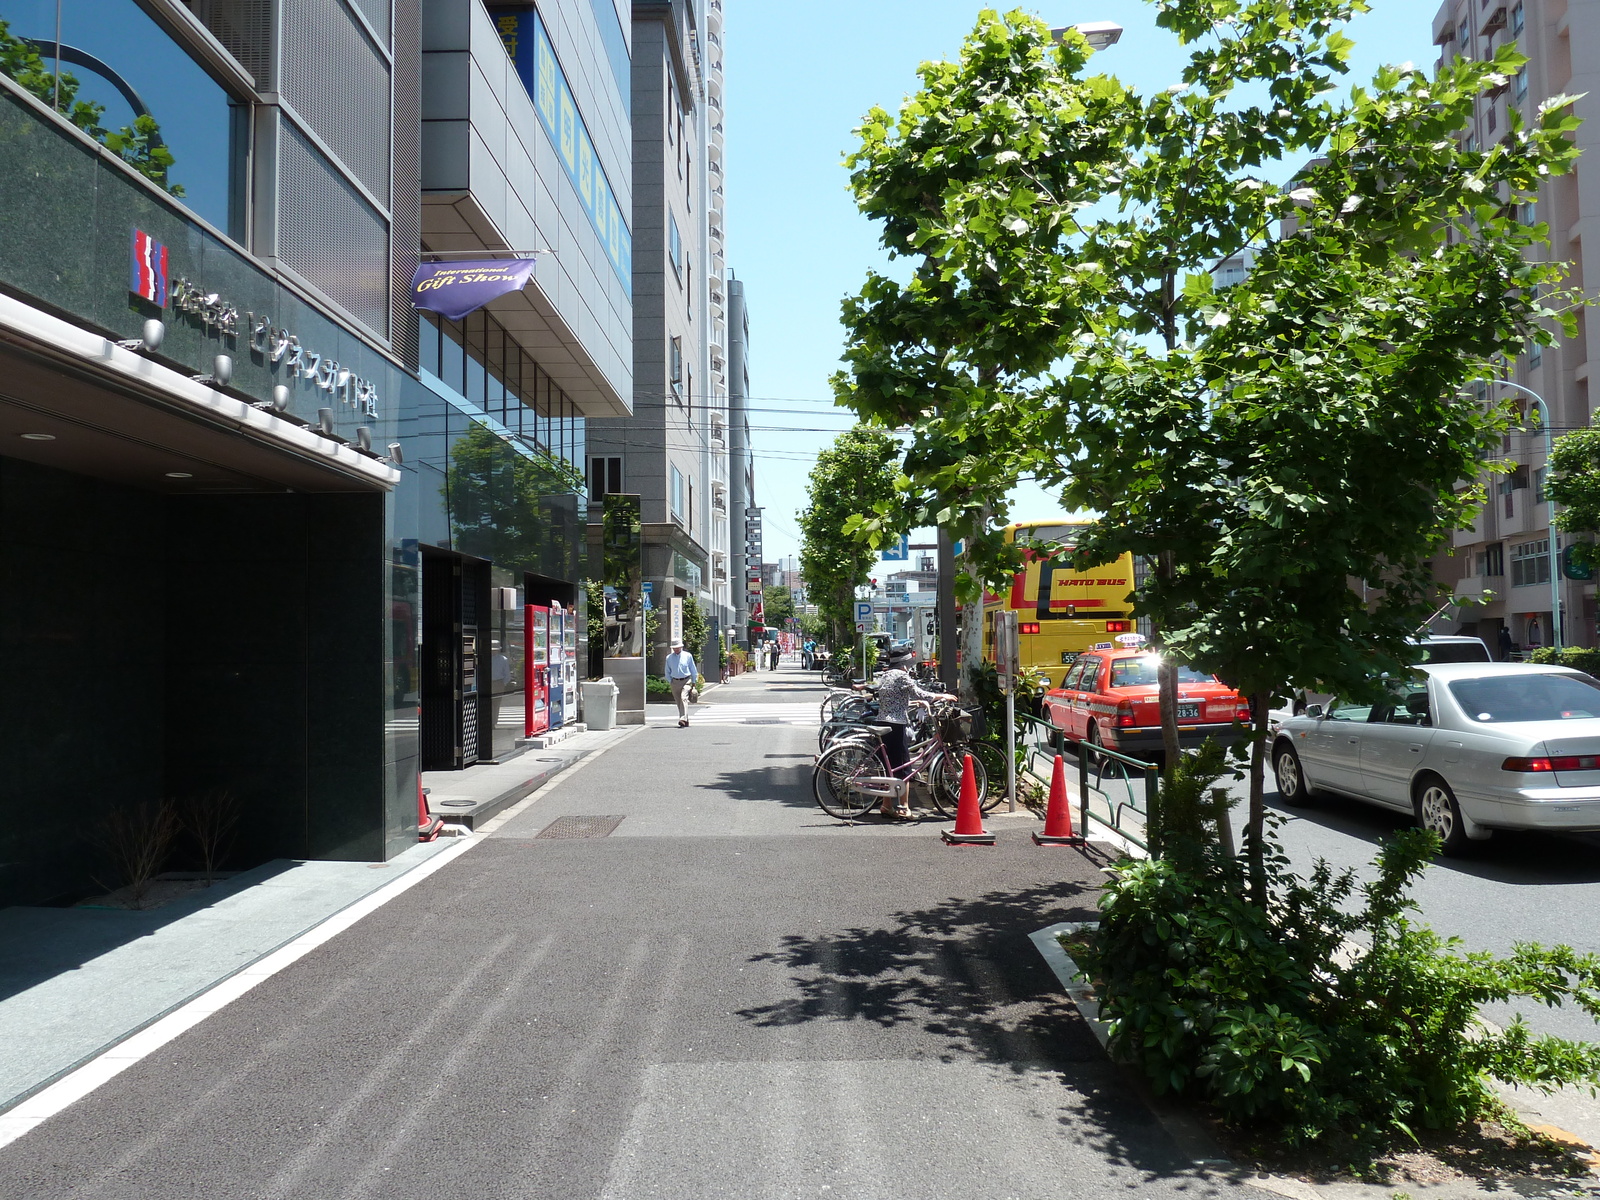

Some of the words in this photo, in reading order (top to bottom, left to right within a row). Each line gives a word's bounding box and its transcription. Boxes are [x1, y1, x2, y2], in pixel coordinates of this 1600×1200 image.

[434, 267, 509, 277] International
[417, 275, 456, 293] Gift
[459, 273, 519, 284] Show
[858, 604, 871, 620] P
